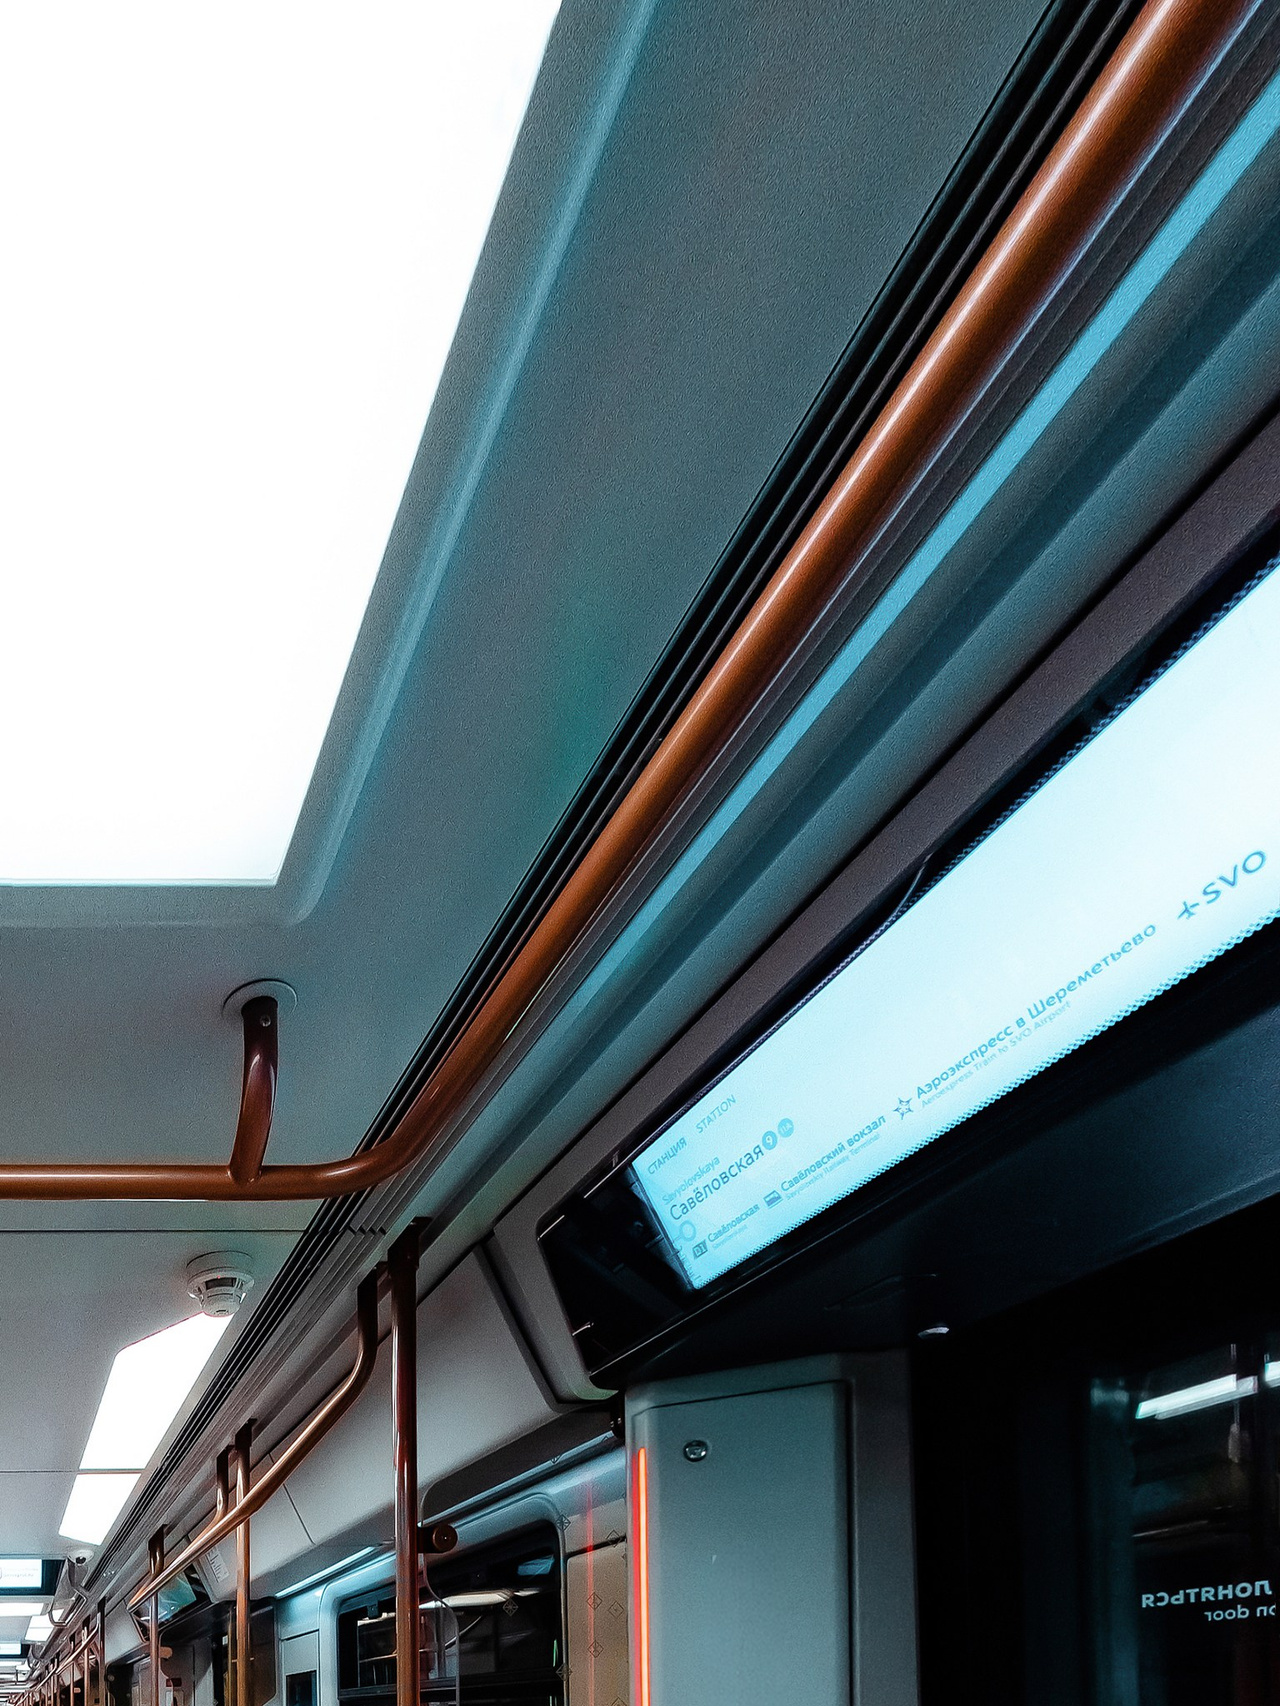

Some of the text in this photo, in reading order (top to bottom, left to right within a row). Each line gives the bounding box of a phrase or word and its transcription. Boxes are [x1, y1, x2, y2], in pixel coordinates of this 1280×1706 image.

[1202, 850, 1267, 904] SVO
[916, 924, 1156, 1100] Аэроэкспресс в Шереметьево
[695, 1094, 737, 1134] STATION
[647, 1137, 688, 1175] СТАНЦИЯ
[669, 1144, 764, 1221] Савёловская
[781, 1115, 886, 1192] Савёловский вокзал
